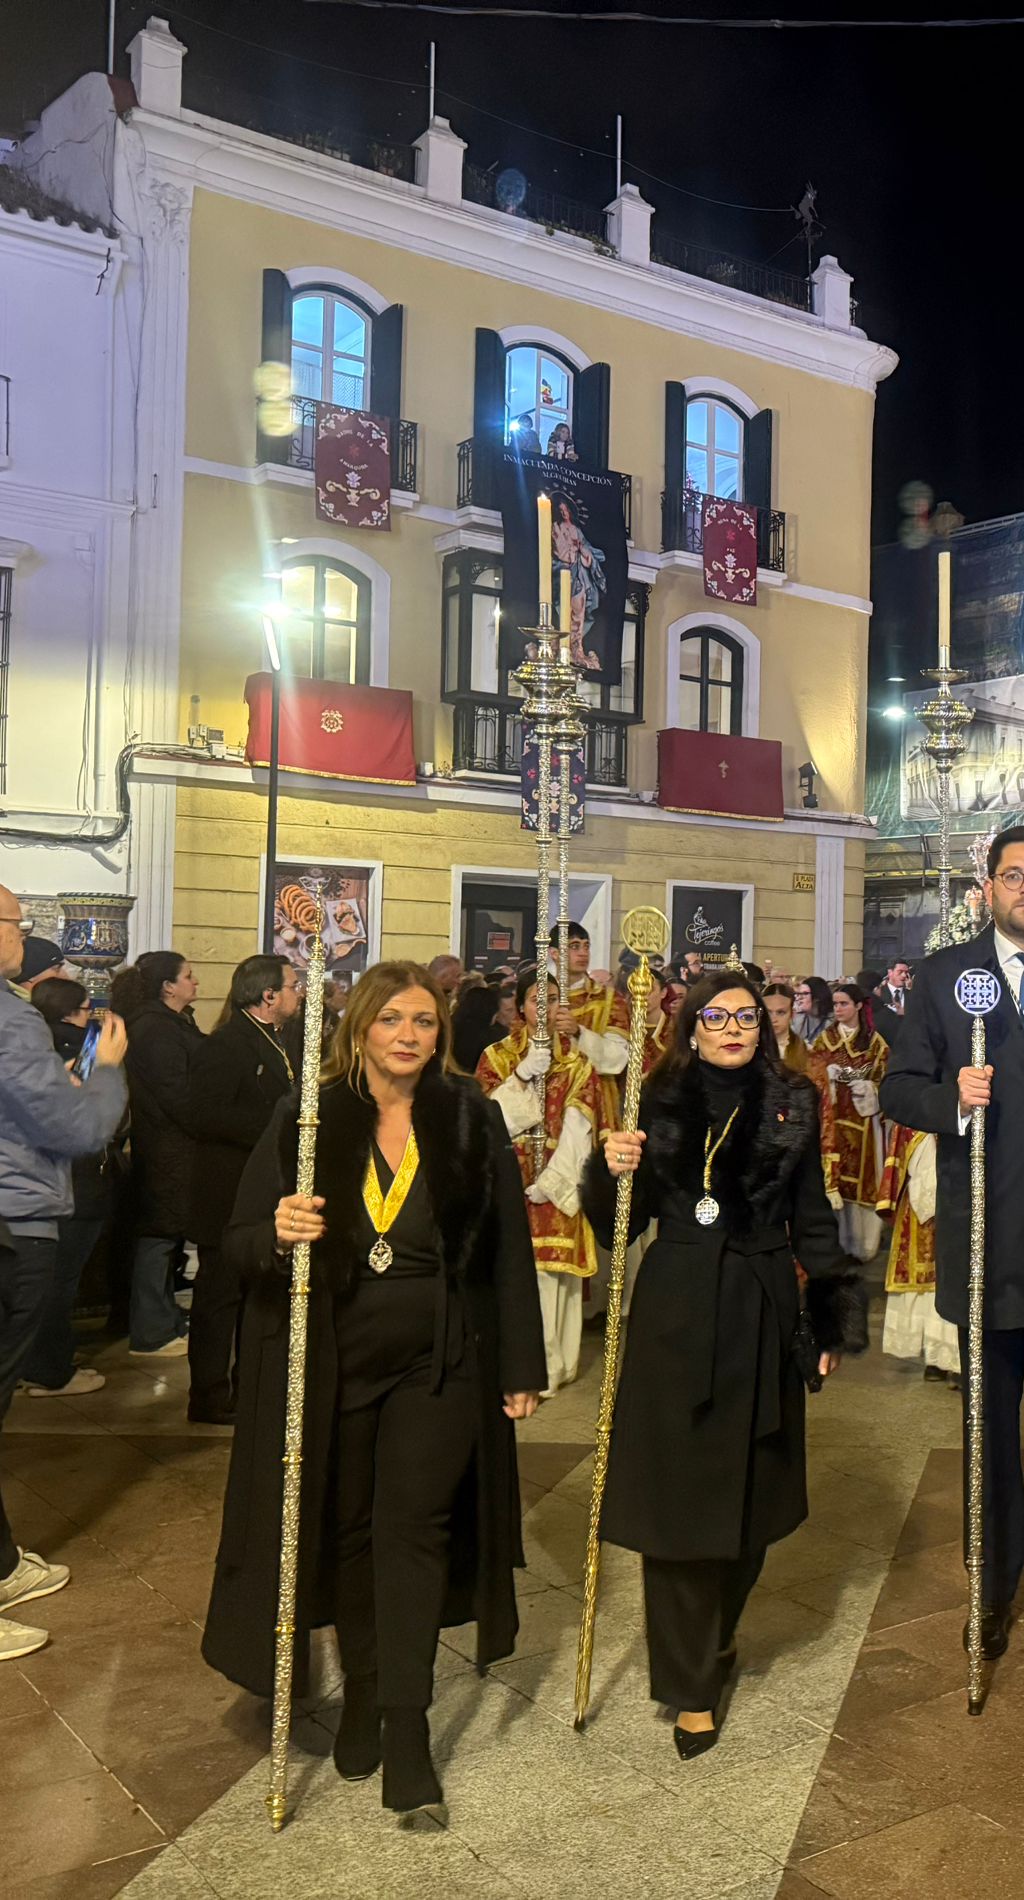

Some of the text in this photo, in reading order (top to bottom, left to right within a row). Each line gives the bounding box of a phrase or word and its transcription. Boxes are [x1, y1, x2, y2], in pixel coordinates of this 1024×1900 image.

[503, 453, 612, 487] INMACULADA CONCEPCIÓN
[542, 471, 577, 486] ALGECIRAS
